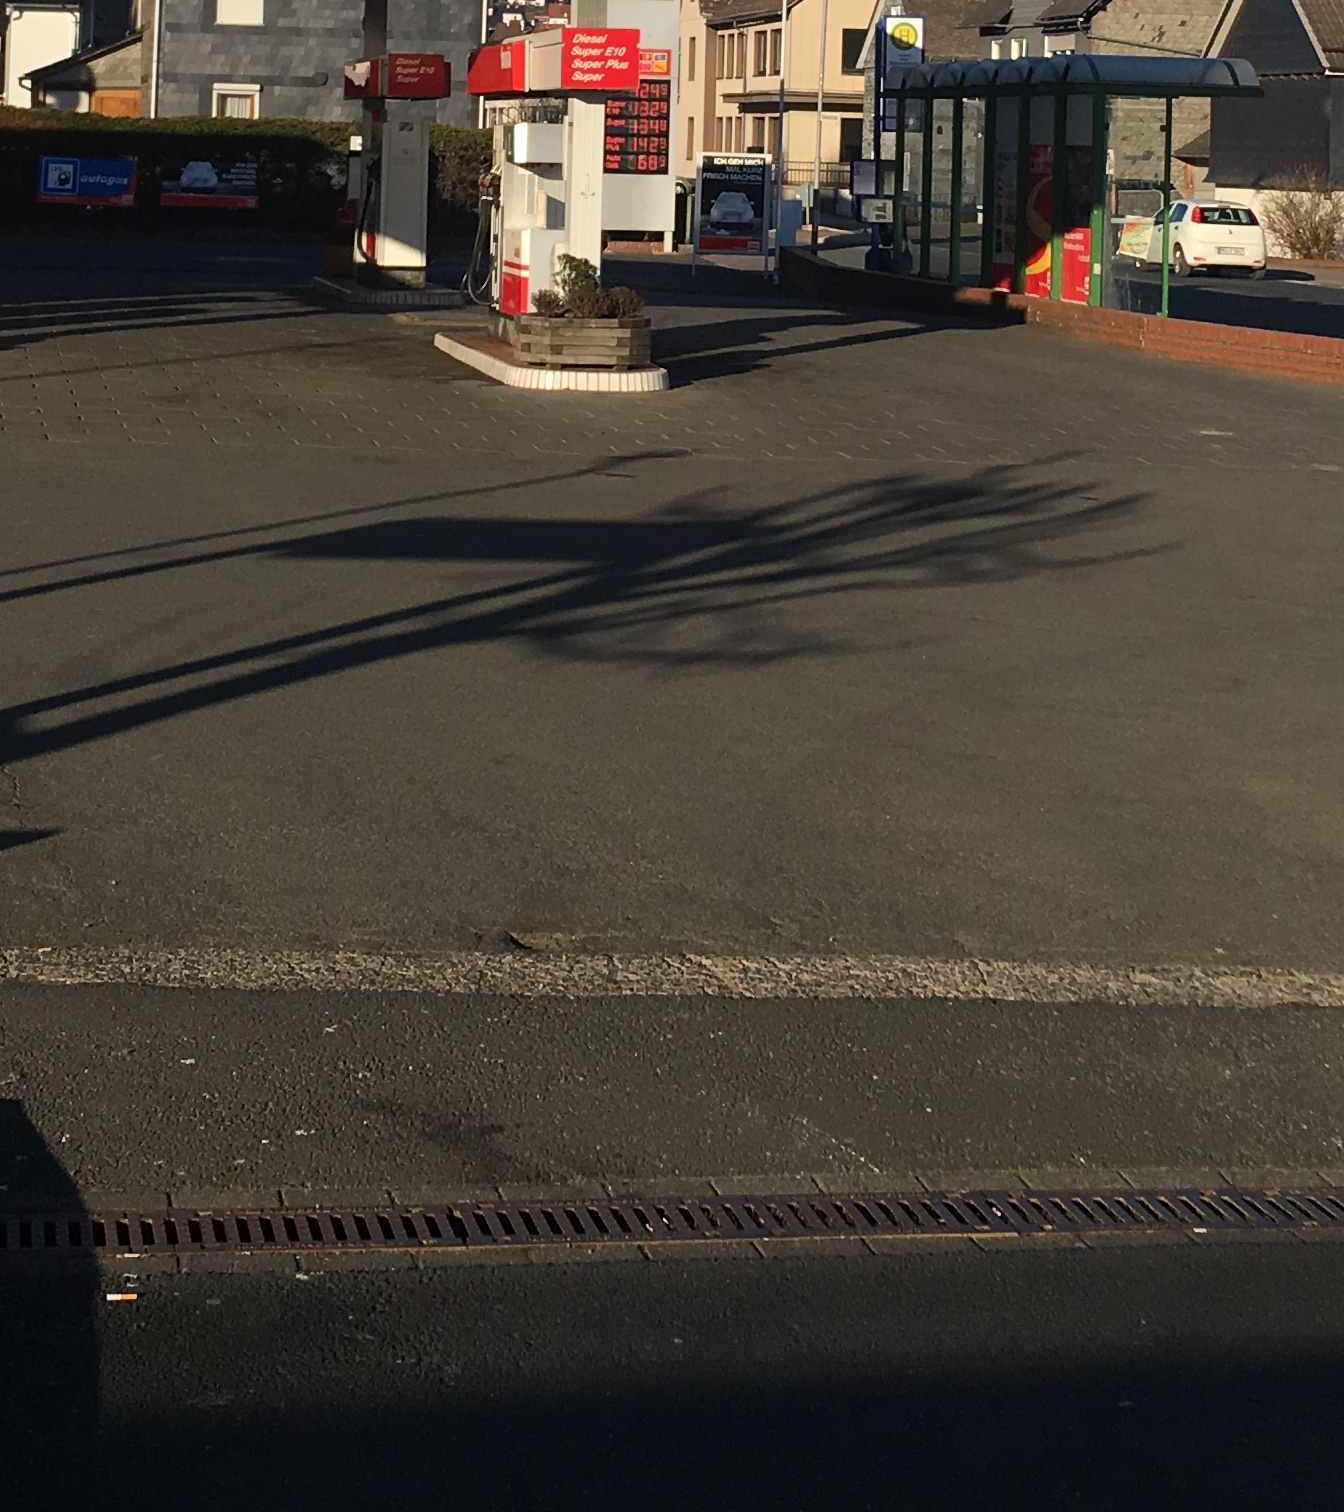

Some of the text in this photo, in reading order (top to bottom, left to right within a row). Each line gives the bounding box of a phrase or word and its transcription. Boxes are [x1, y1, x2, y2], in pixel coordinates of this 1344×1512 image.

[572, 33, 608, 44] Diesel
[570, 45, 627, 58] Super E10
[395, 57, 421, 66] Diesel
[571, 58, 630, 70] Super Plus
[395, 66, 435, 75] Super E10
[397, 74, 420, 83] Super
[571, 70, 606, 83] Super
[80, 173, 129, 186] autogas
